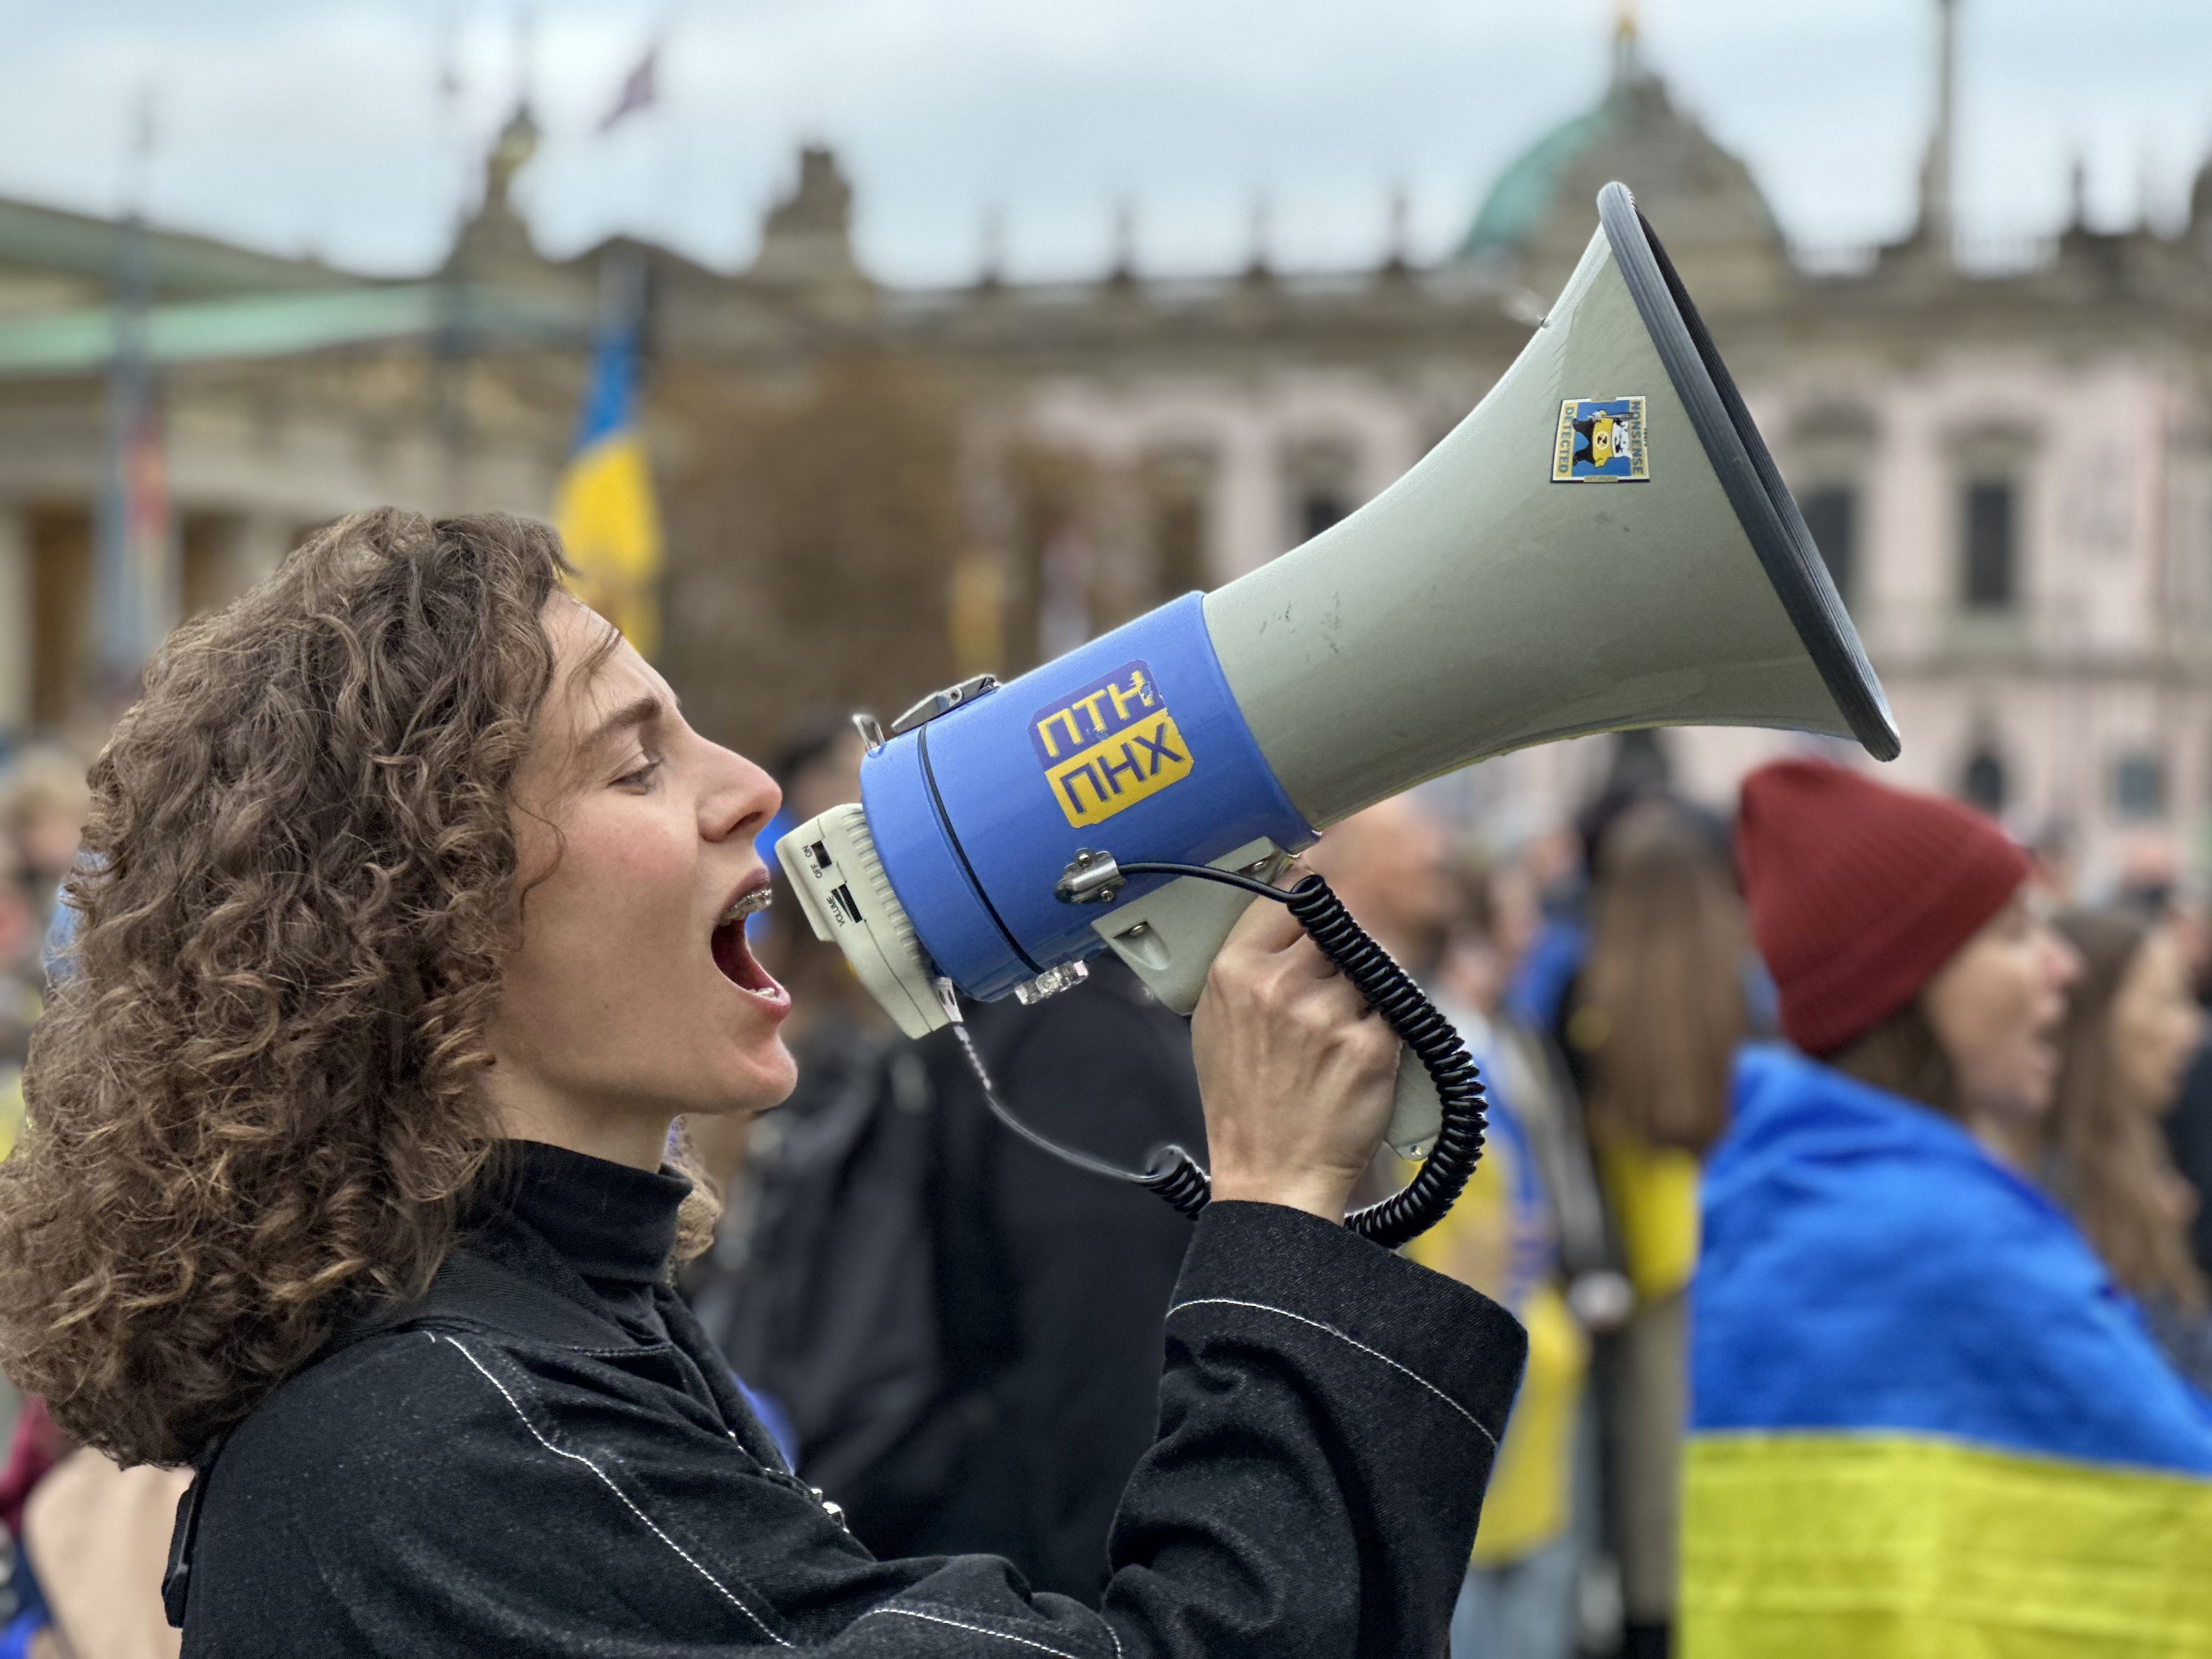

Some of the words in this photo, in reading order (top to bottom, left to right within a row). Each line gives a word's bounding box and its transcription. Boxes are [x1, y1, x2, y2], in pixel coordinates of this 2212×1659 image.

[1558, 407, 1575, 473] DETECTED
[1631, 401, 1643, 475] NONSENSE
[1037, 670, 1154, 758] ПТН
[1059, 722, 1184, 814] ПНХ
[802, 845, 812, 857] ON
[811, 863, 822, 879] OFF
[826, 895, 845, 927] VOLUME
